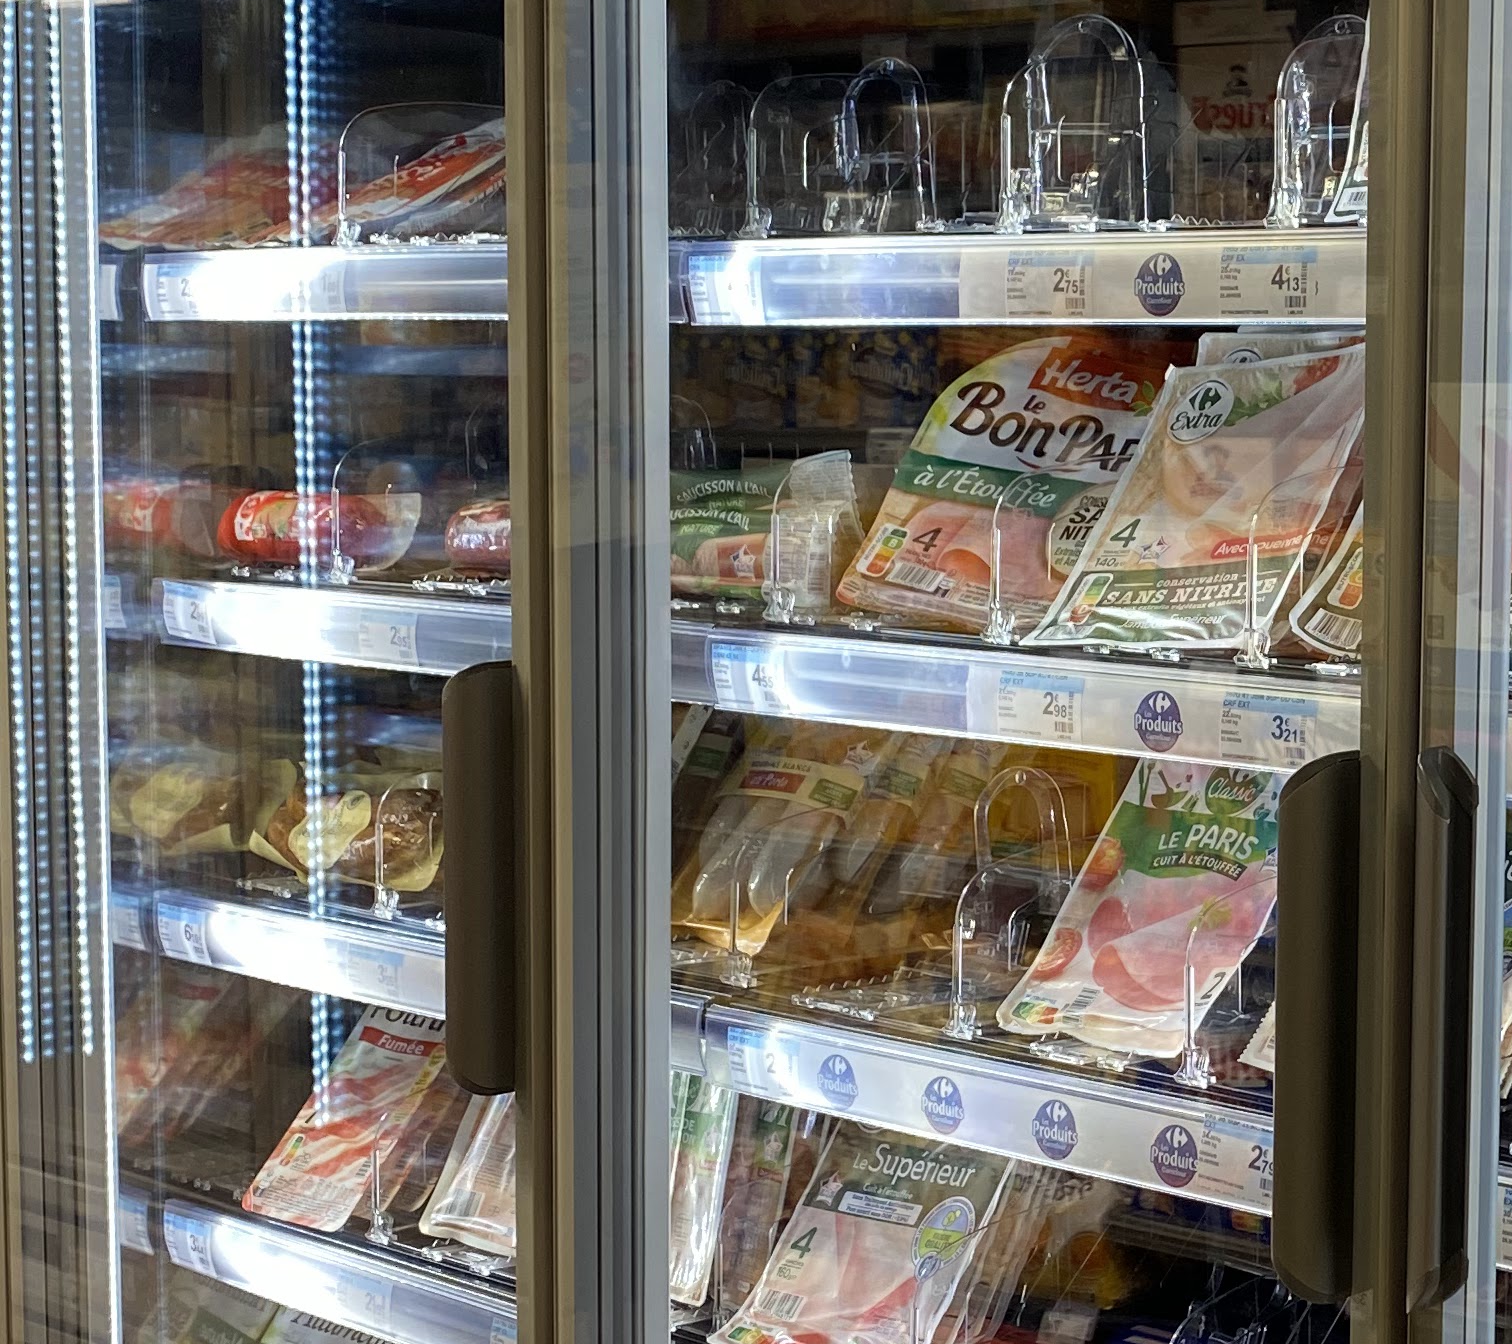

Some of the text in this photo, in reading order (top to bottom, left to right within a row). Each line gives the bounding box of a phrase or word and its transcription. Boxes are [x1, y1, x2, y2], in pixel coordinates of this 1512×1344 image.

[1134, 280, 1186, 296] Produits
[1041, 358, 1138, 403] Herta
[1024, 395, 1046, 414] le
[950, 381, 1055, 457] Bon
[1169, 407, 1224, 431] Extra
[1102, 589, 1168, 605] SANS
[1157, 822, 1260, 860] LE PARIS
[378, 1034, 424, 1054] Fumée
[853, 1144, 976, 1187] Le Supérieur
